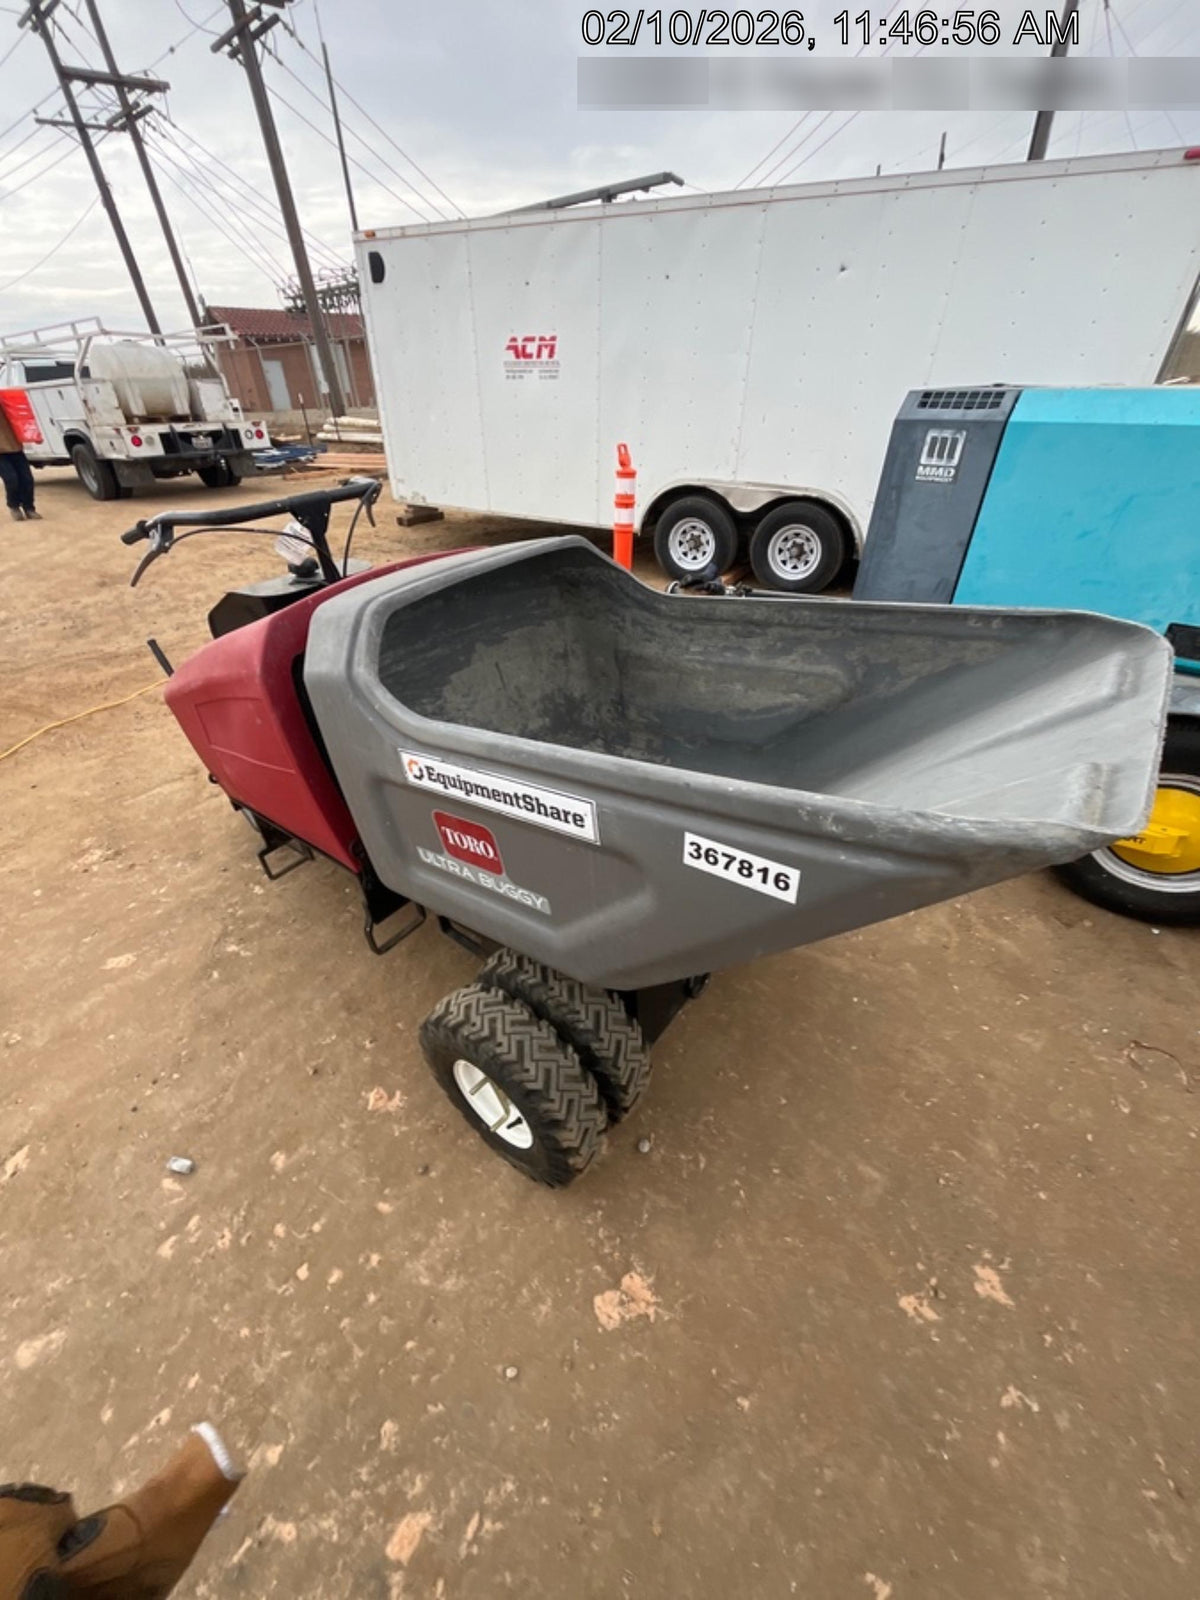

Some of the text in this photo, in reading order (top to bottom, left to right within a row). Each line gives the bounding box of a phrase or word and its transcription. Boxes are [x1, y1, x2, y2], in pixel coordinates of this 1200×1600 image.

[504, 335, 557, 360] ACM
[425, 766, 585, 828] EquipmentShare
[441, 826, 496, 859] TORO
[688, 842, 791, 892] 367816
[417, 846, 546, 910] ULTRA BUGGY
